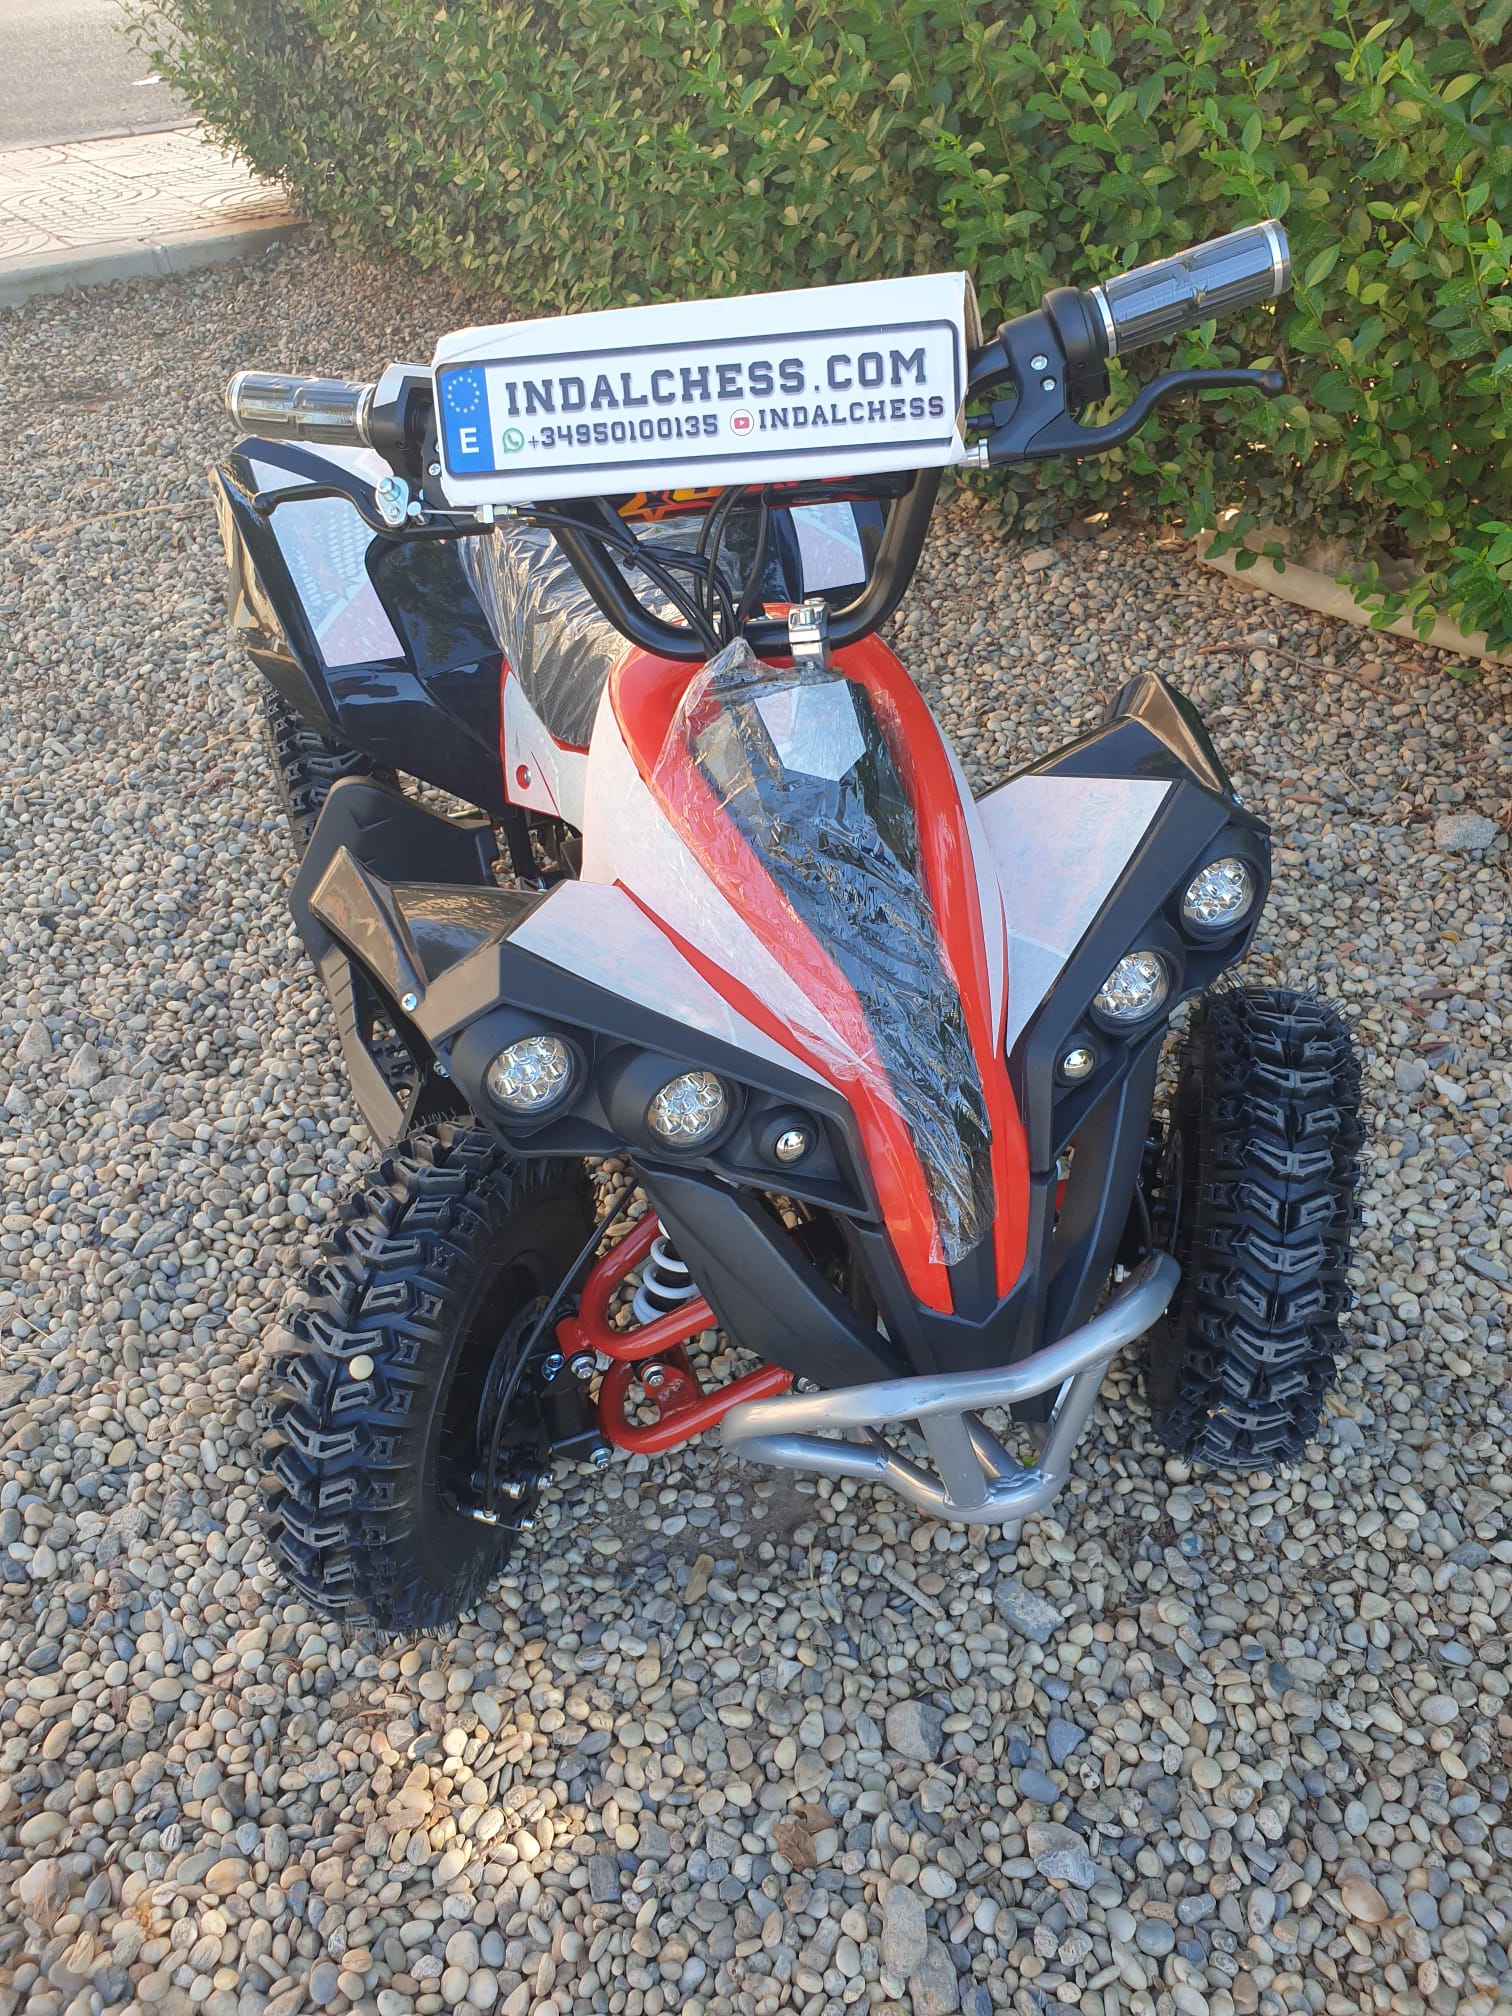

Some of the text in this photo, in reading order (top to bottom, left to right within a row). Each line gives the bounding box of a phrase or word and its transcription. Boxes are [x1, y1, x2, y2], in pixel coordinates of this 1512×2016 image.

[505, 347, 927, 416] INDALCHESS.COM
[459, 427, 480, 455] E
[527, 395, 945, 450] +34950100135 INDALCHESS
